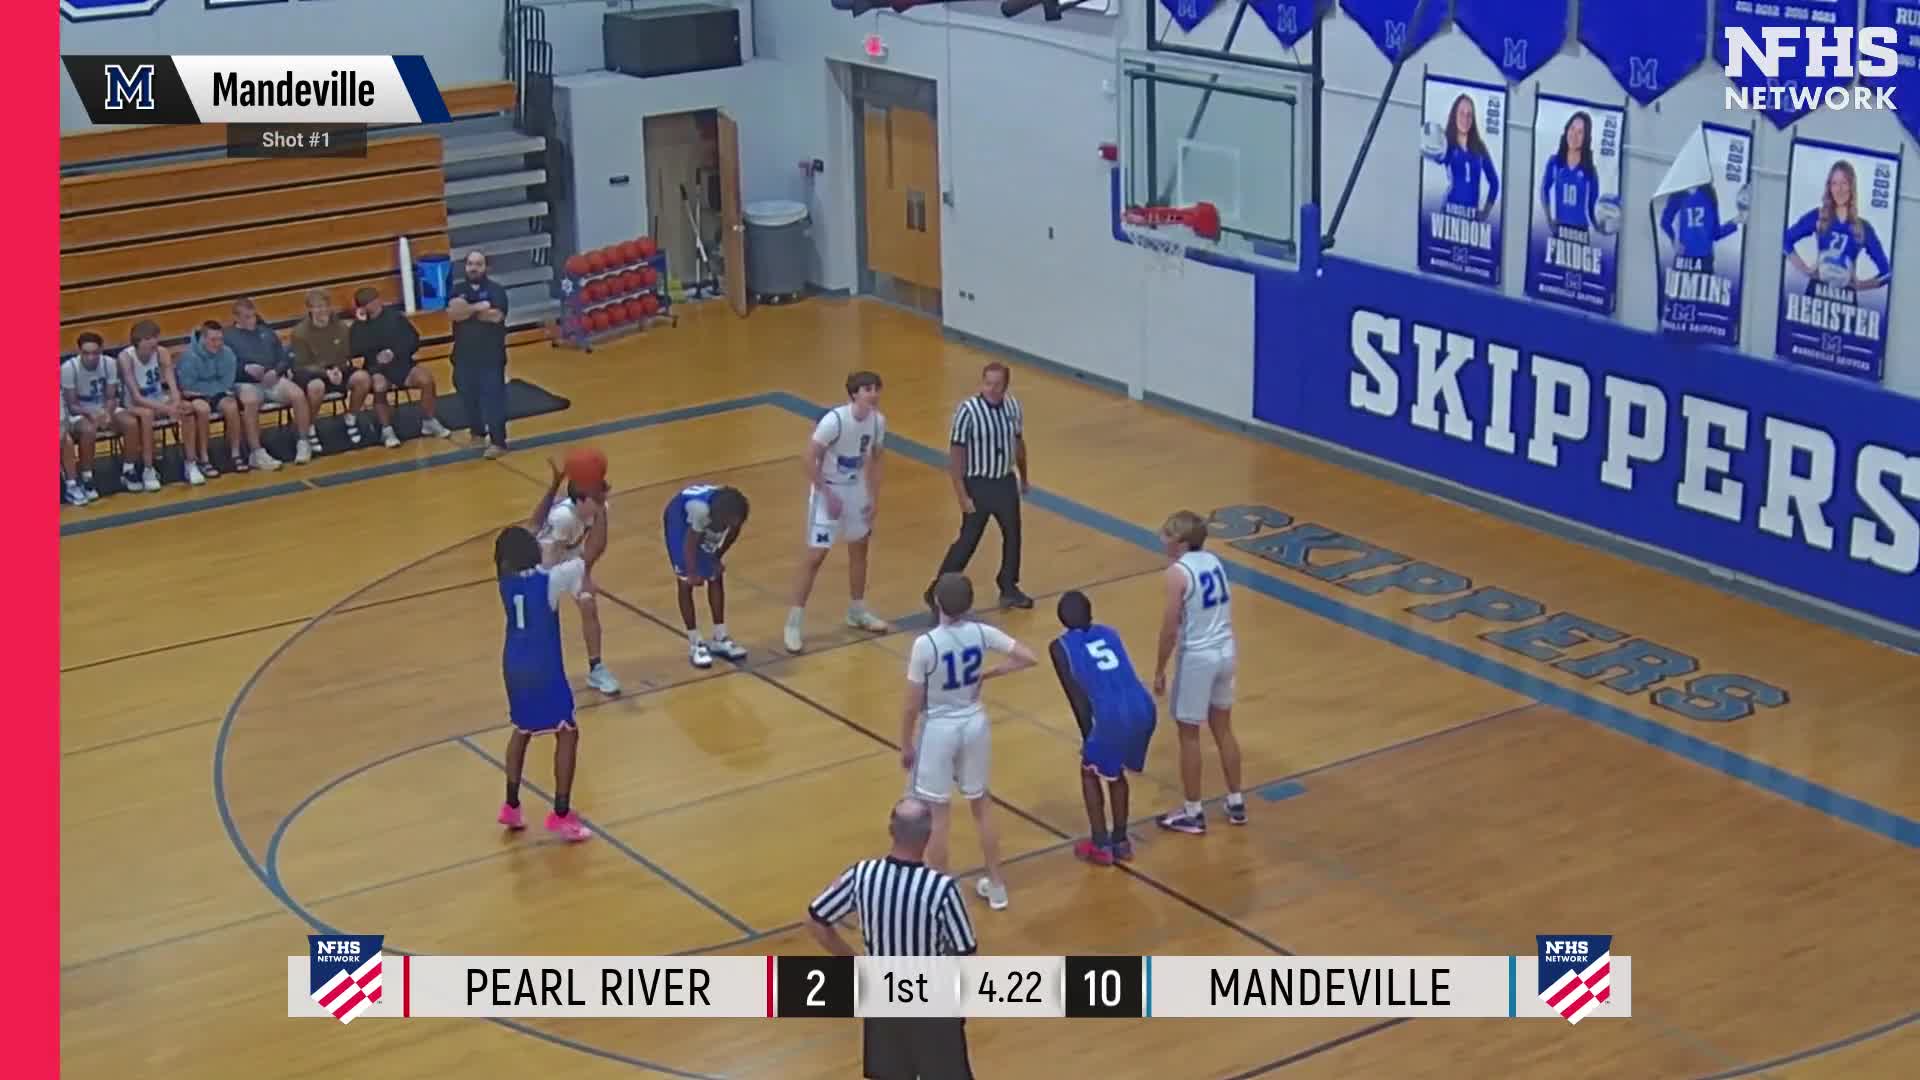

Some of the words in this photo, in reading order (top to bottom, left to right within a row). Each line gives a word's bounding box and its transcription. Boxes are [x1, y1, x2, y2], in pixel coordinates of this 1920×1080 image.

[1503, 37, 1528, 70] M
[1629, 56, 1658, 90] M
[1431, 212, 1493, 250] WINDOM
[1687, 207, 1705, 228] 12
[1545, 237, 1602, 274] FRIDGE
[1786, 292, 1881, 340] REGISTER
[1349, 310, 1920, 575] SKIPPERS
[1199, 565, 1230, 609] 21
[513, 594, 525, 629] 1
[1206, 504, 1790, 722] SKIPPERS
[941, 645, 983, 691] 12
[1085, 639, 1119, 671] 5
